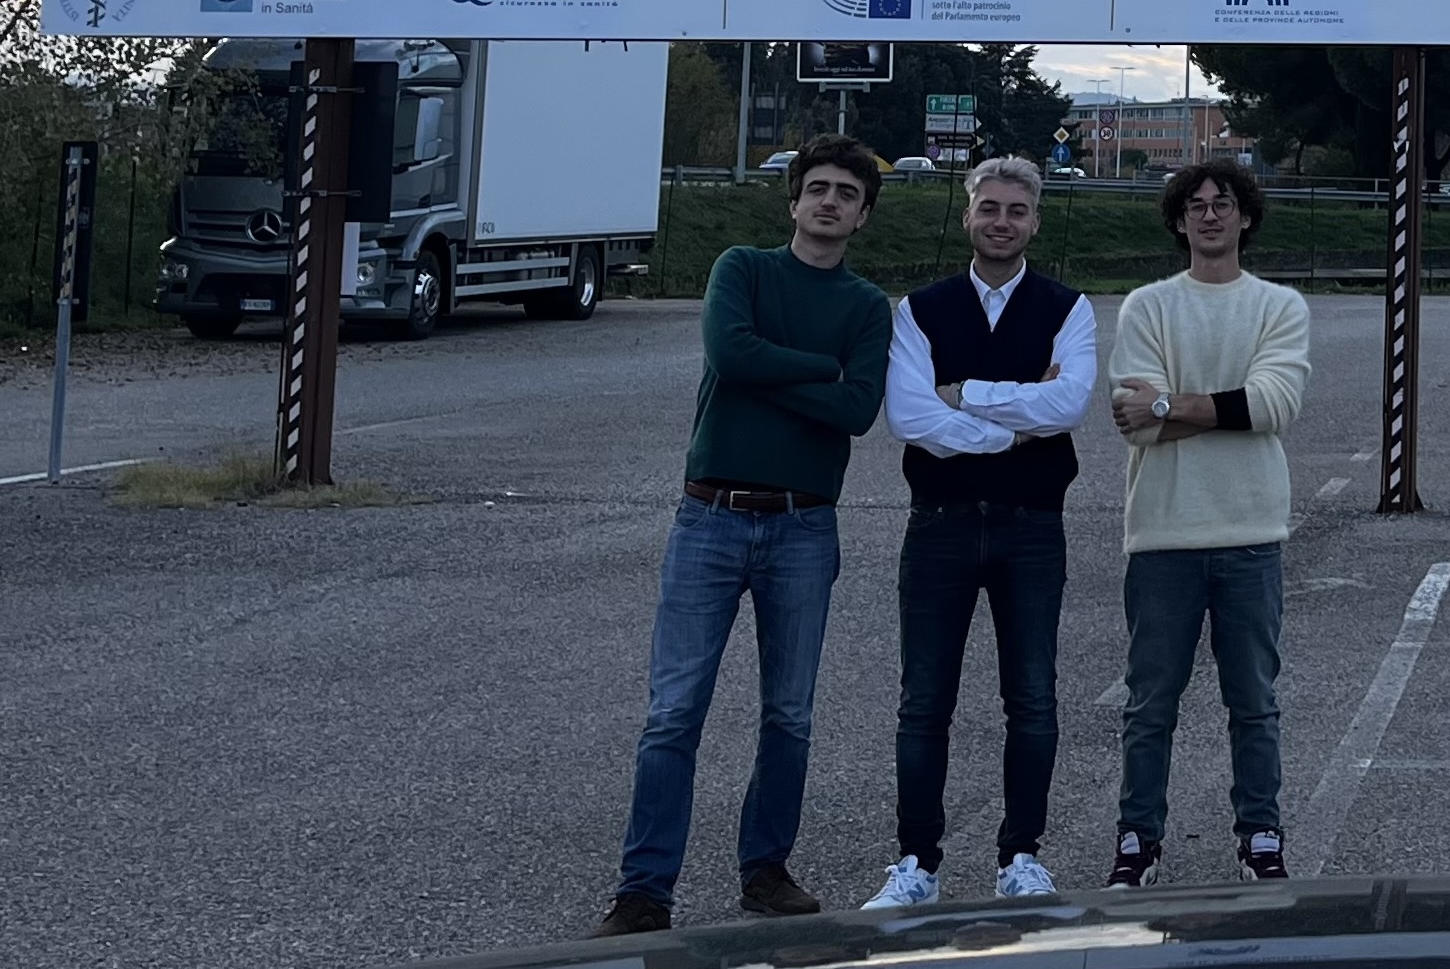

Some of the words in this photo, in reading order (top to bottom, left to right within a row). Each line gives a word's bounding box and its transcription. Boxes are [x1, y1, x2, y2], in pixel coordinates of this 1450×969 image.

[262, 2, 272, 13] in
[276, 2, 313, 13] Sanità
[932, 1, 951, 9] sotto
[973, 2, 1011, 11] patrocinio
[932, 12, 943, 20] del
[945, 12, 988, 20] Parlamento
[990, 14, 1020, 22] europeo
